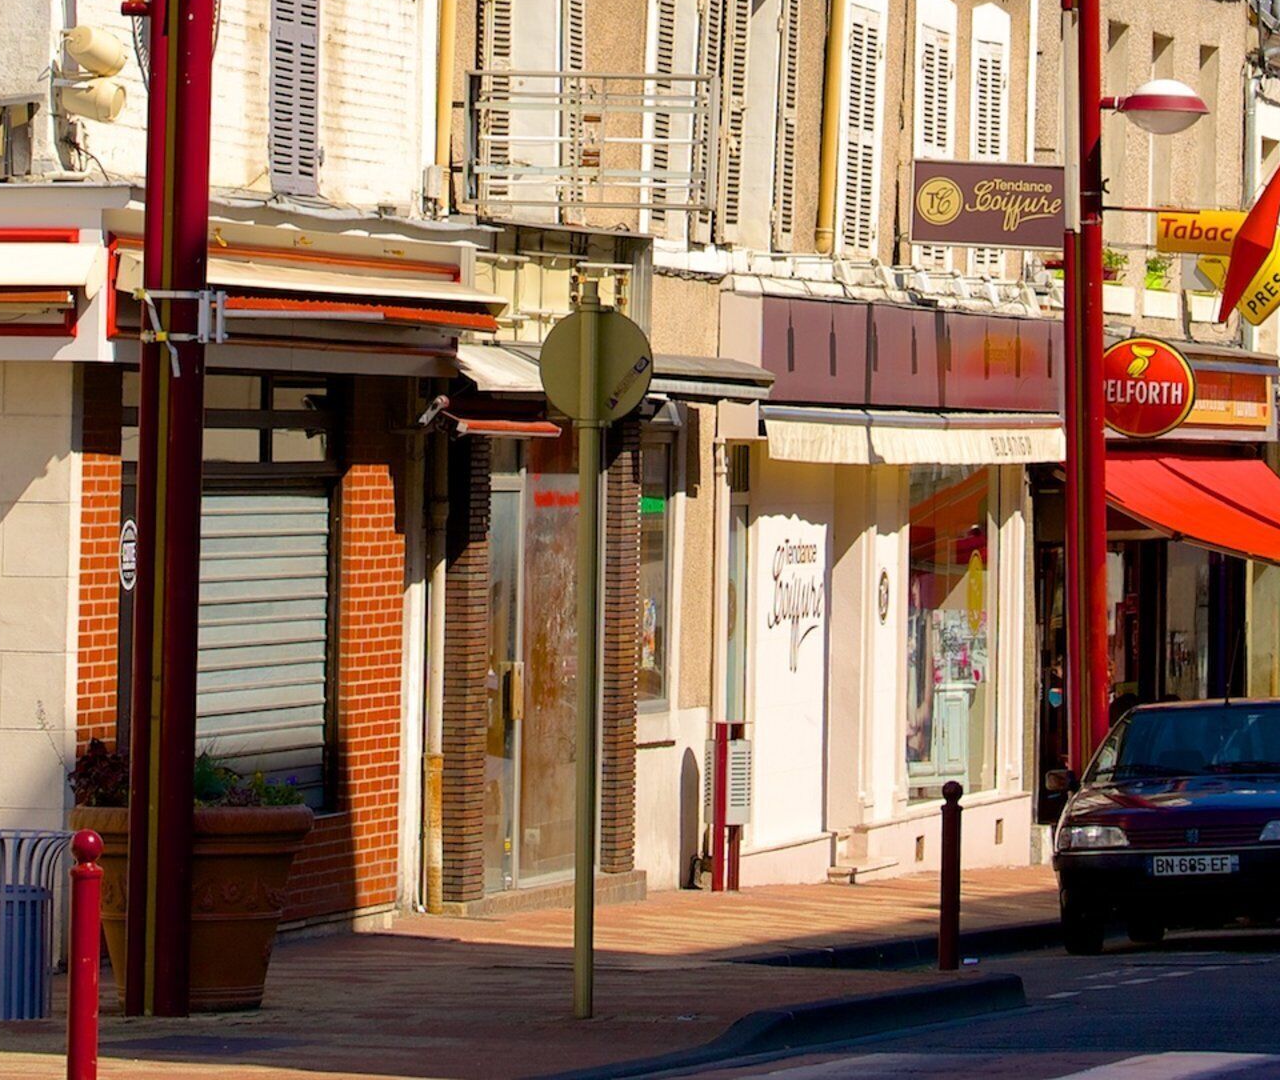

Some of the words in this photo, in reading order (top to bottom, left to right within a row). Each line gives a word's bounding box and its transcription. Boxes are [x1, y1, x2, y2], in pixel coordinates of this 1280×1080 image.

[993, 178, 1053, 193] Tendance
[965, 180, 1062, 232] Coiffure
[1160, 217, 1233, 242] Tabac
[1104, 379, 1184, 405] ELFORTH
[784, 538, 817, 564] Tendance
